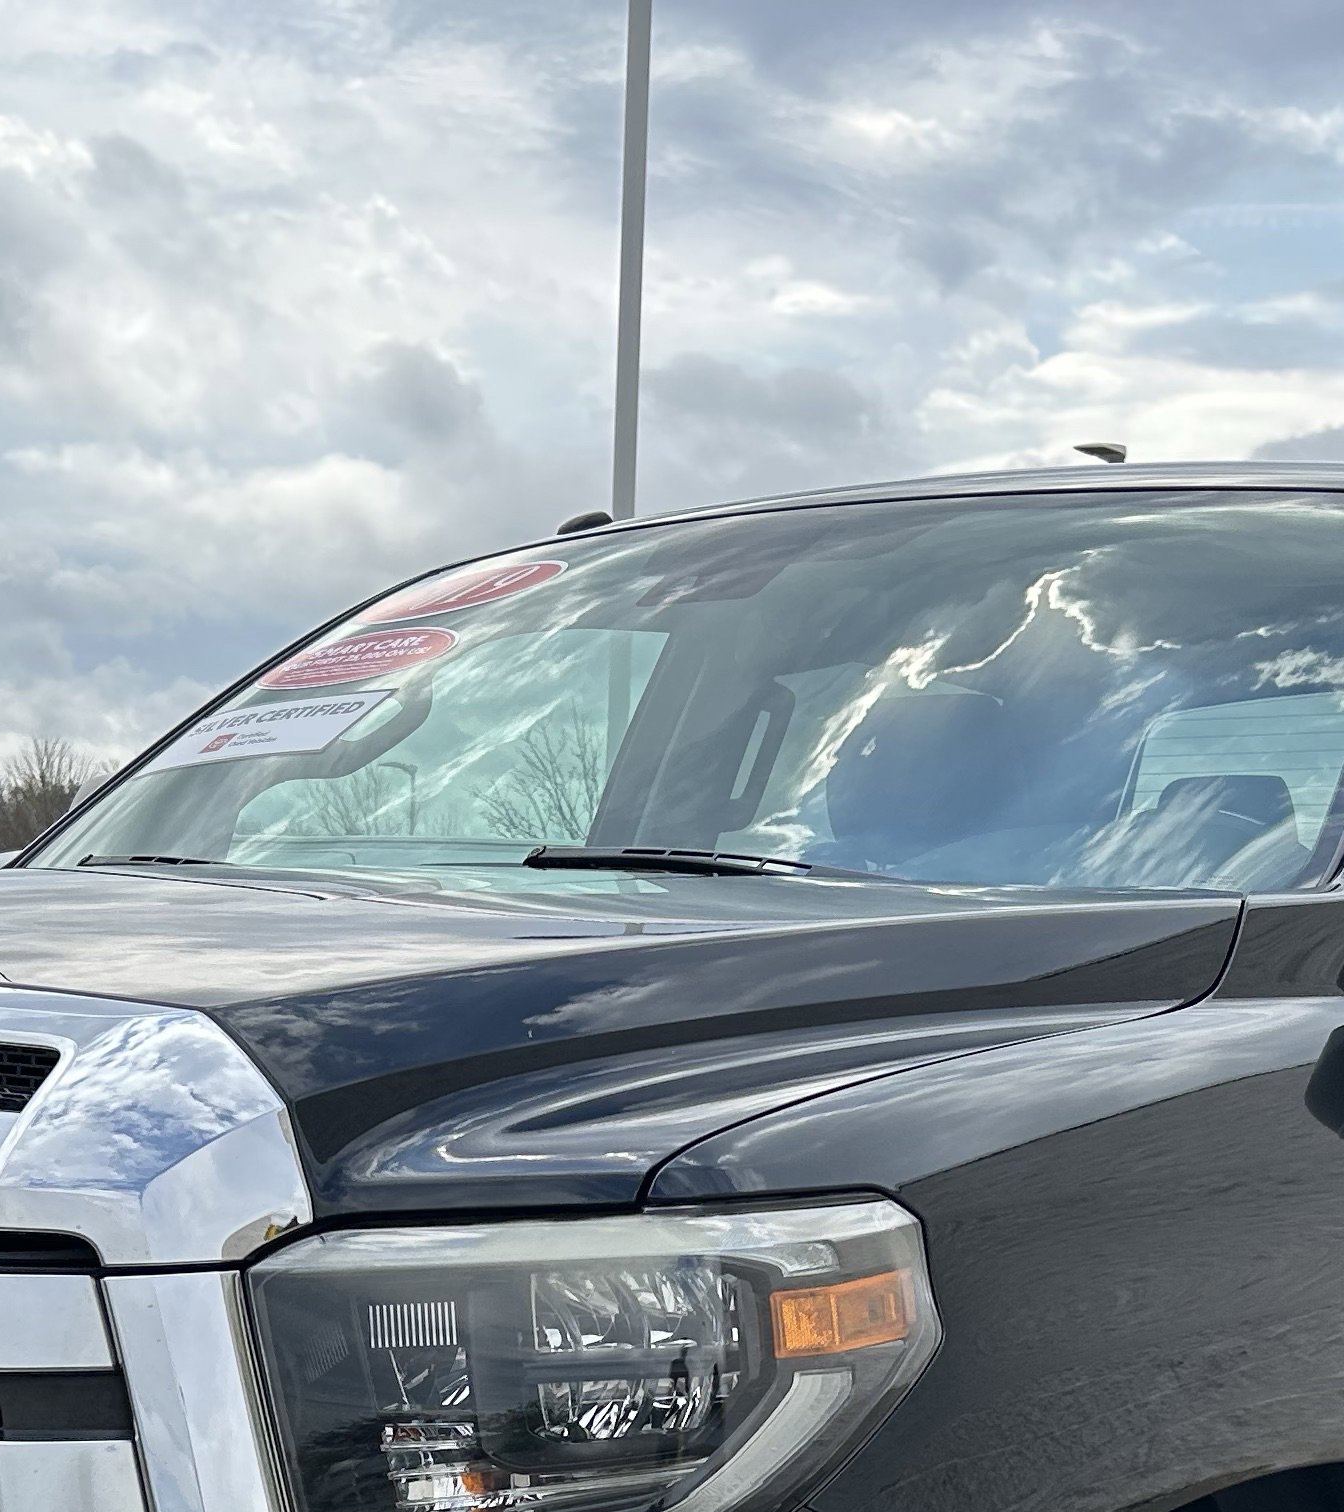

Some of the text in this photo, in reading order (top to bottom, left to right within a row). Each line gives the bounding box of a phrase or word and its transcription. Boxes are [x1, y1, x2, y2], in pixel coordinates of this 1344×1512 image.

[373, 635, 430, 650] CARE
[188, 701, 365, 738] SILVER CERTIFIED
